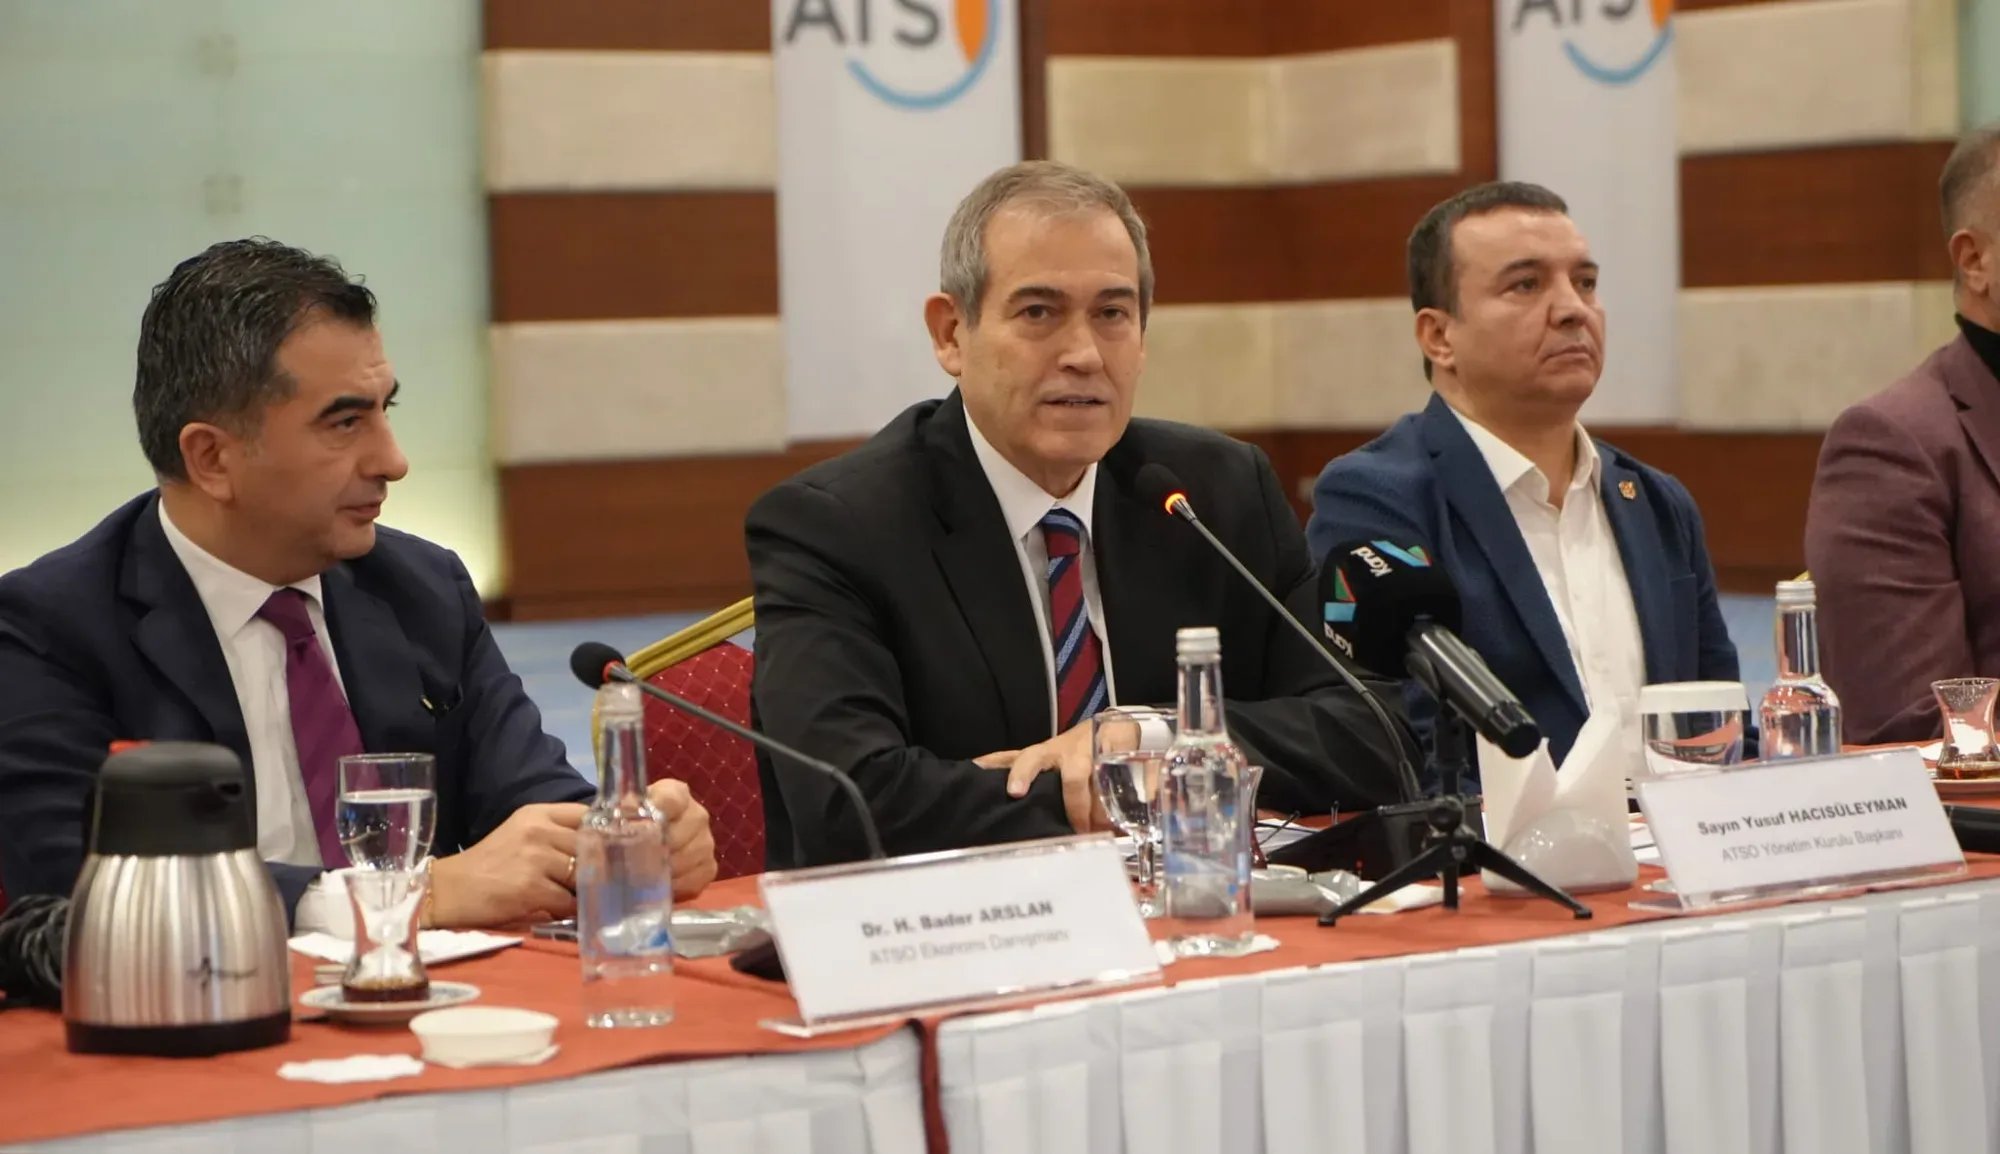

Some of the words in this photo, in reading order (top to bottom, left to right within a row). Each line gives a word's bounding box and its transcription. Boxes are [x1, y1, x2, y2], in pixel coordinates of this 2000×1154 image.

[1697, 818, 1740, 836] Sayın
[1743, 811, 1785, 829] Yusuf
[1789, 796, 1908, 824] HACISÜLEYMAN
[1721, 846, 1759, 862] ATSO
[1763, 837, 1812, 857] Yönetim
[1814, 831, 1854, 849] Kurulu
[861, 921, 890, 938] Dr.
[894, 916, 915, 933] H.
[979, 900, 1053, 923] ARSLAN
